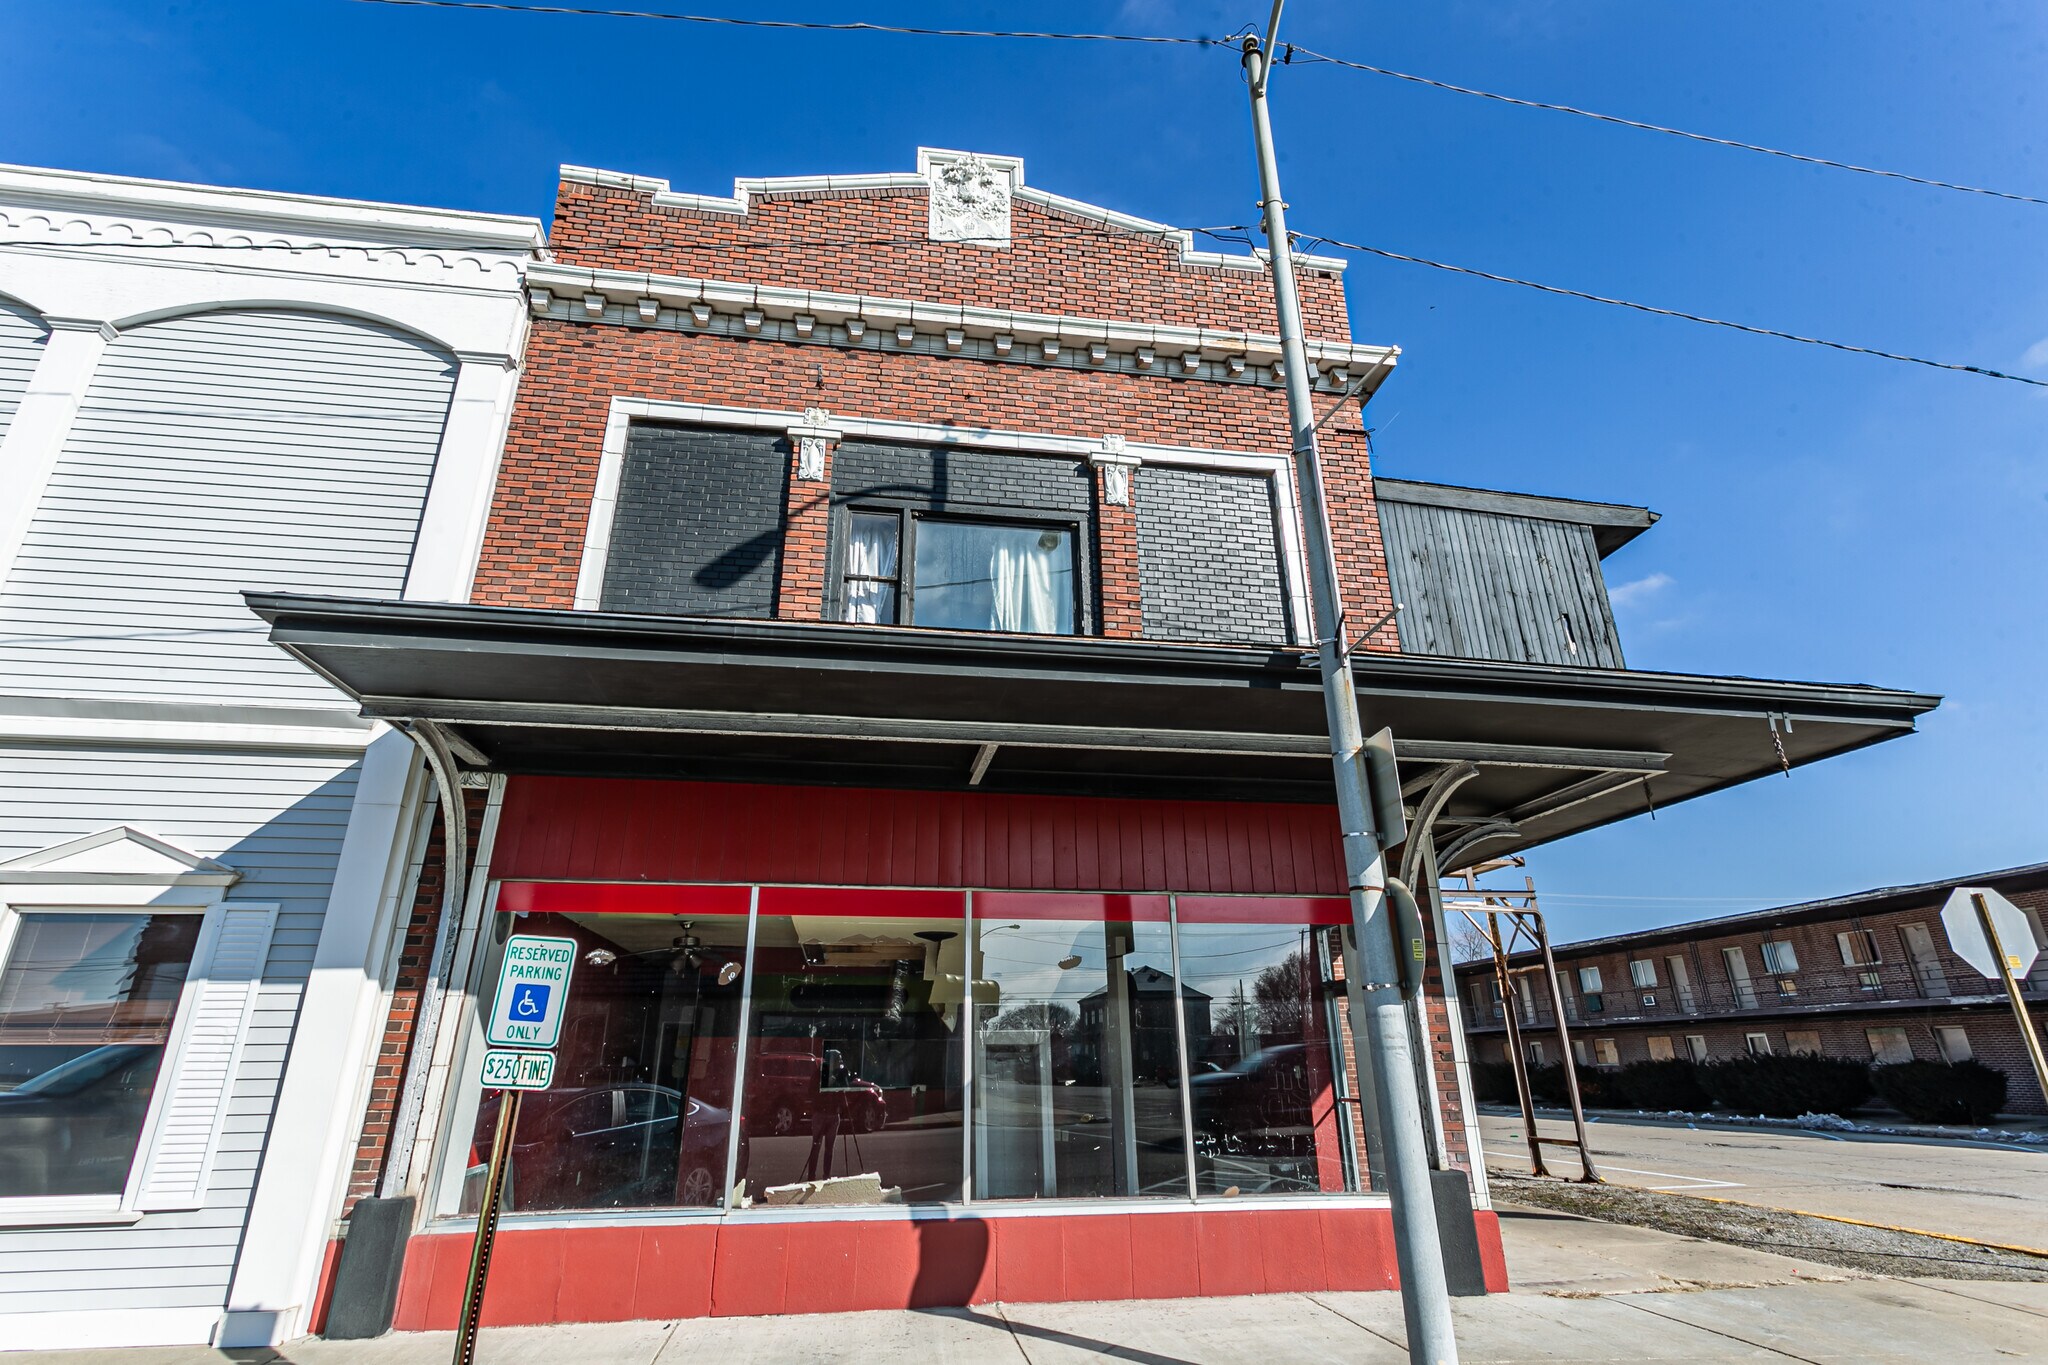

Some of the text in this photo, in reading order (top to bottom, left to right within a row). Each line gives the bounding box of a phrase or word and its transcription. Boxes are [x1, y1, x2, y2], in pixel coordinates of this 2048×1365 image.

[510, 947, 569, 963] RESERVED
[510, 965, 563, 980] PARKING
[506, 1025, 541, 1040] ONLY
[486, 1058, 549, 1081] $250 FINE
